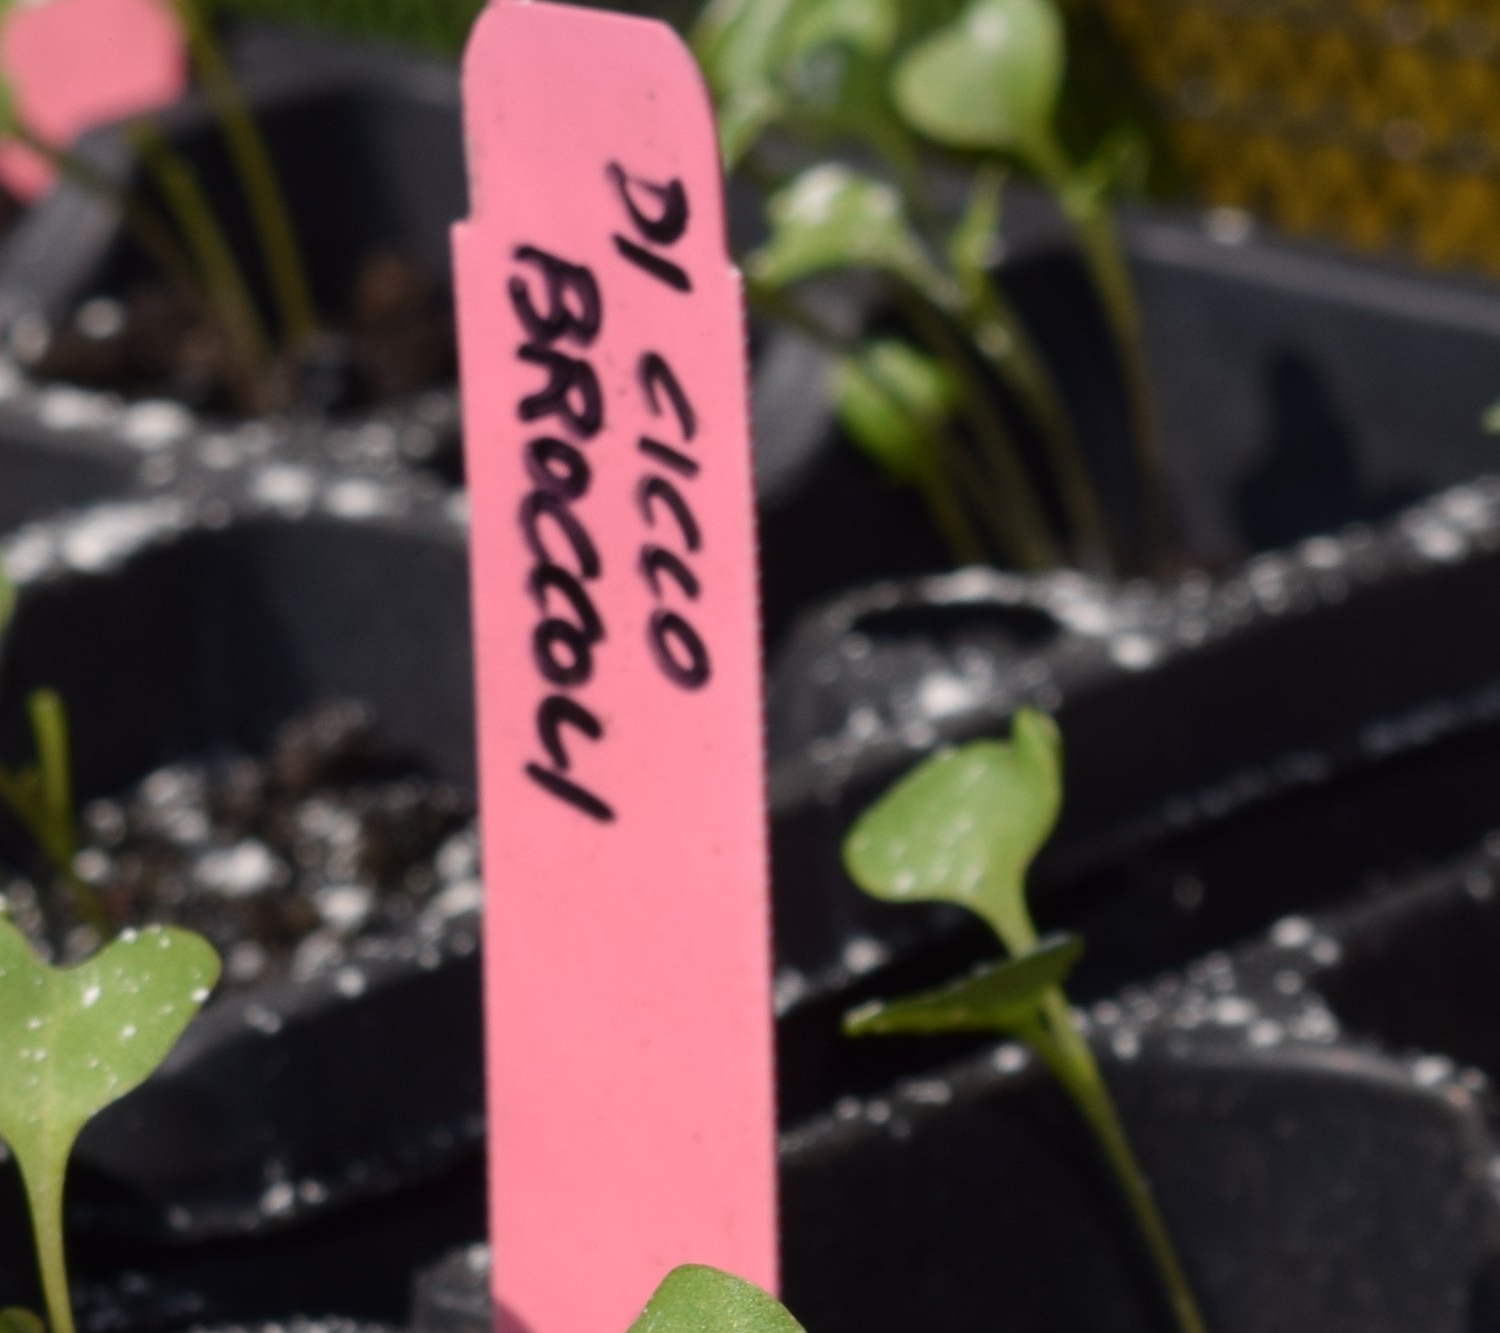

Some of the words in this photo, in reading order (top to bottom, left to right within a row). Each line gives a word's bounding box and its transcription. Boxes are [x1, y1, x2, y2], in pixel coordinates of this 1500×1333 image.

[606, 161, 693, 293] DI
[508, 243, 617, 824] BROCCOLI
[636, 350, 712, 691] CICCO
